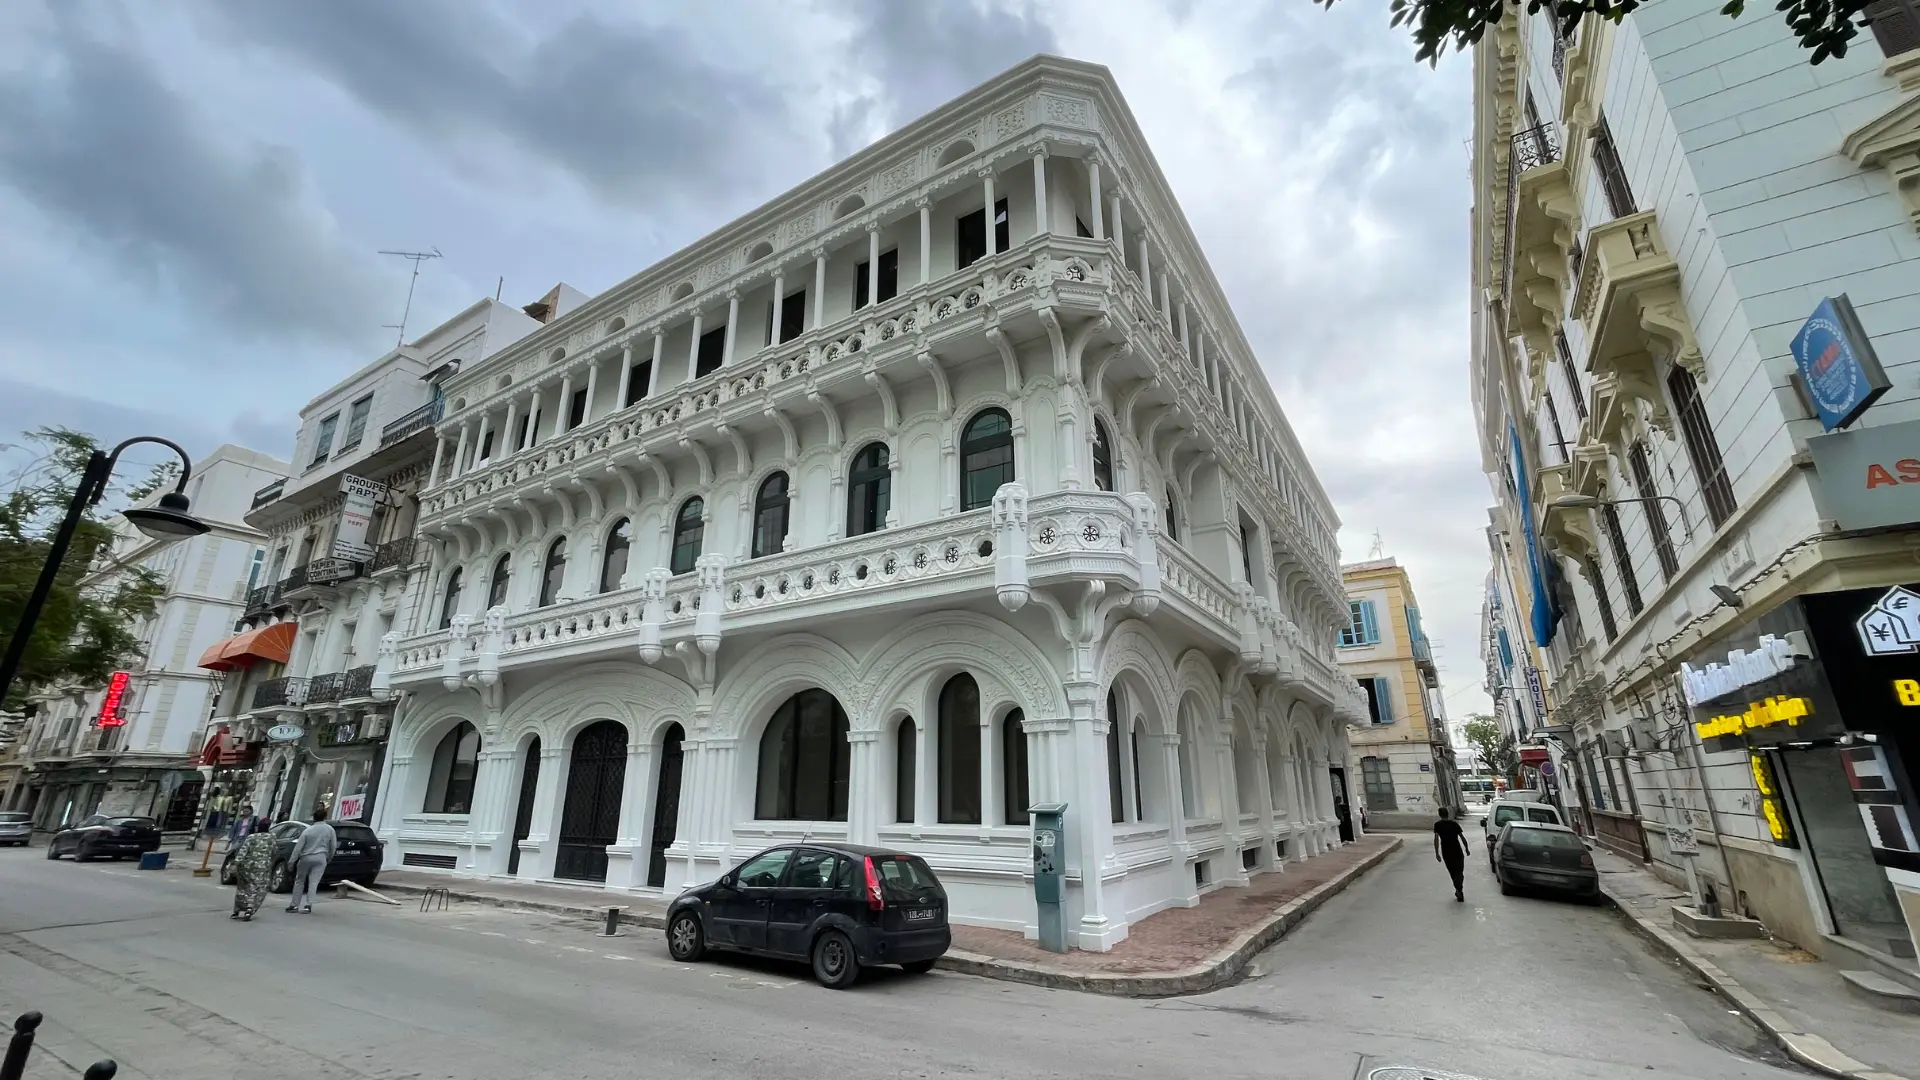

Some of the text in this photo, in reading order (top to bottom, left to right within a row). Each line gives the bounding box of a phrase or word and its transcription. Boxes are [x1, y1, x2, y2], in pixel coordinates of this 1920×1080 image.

[345, 475, 386, 493] GROUPE
[348, 485, 378, 499] PAPY
[309, 567, 338, 578] CONTINU
[311, 560, 336, 571] PAPIER
[1529, 677, 1545, 716] HOTEL
[341, 799, 359, 816] TOUT
[1058, 817, 1063, 829] P
